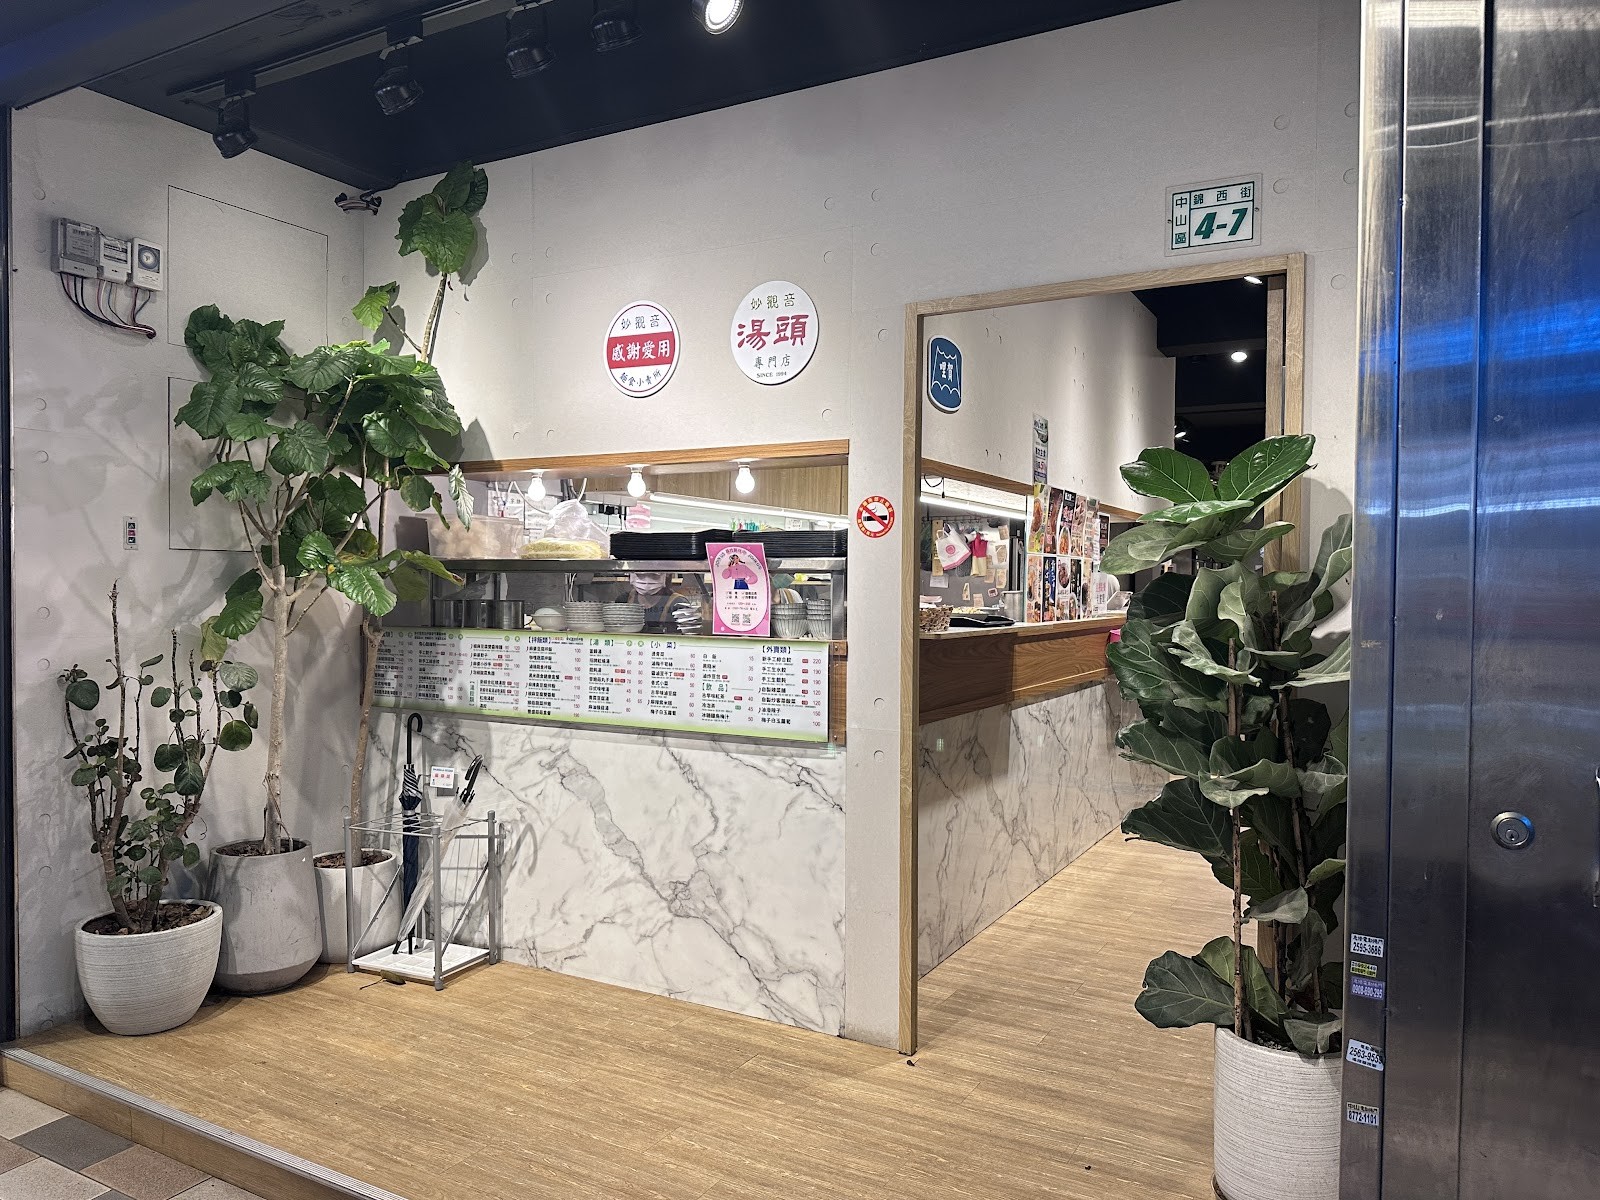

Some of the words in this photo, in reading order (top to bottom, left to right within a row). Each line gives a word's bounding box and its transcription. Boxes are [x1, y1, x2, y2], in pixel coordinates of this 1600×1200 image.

[1193, 186, 1251, 205] 錦西街
[1175, 196, 1187, 244] 中山區
[1194, 208, 1248, 239] 4-7
[750, 293, 796, 311] 妙觀音
[621, 314, 660, 330] 妙觀音
[737, 314, 809, 351] 湯頭
[611, 339, 671, 362] 感謝愛用
[753, 354, 791, 370] 專門店
[1348, 1110, 1377, 1124] 8772-1101
